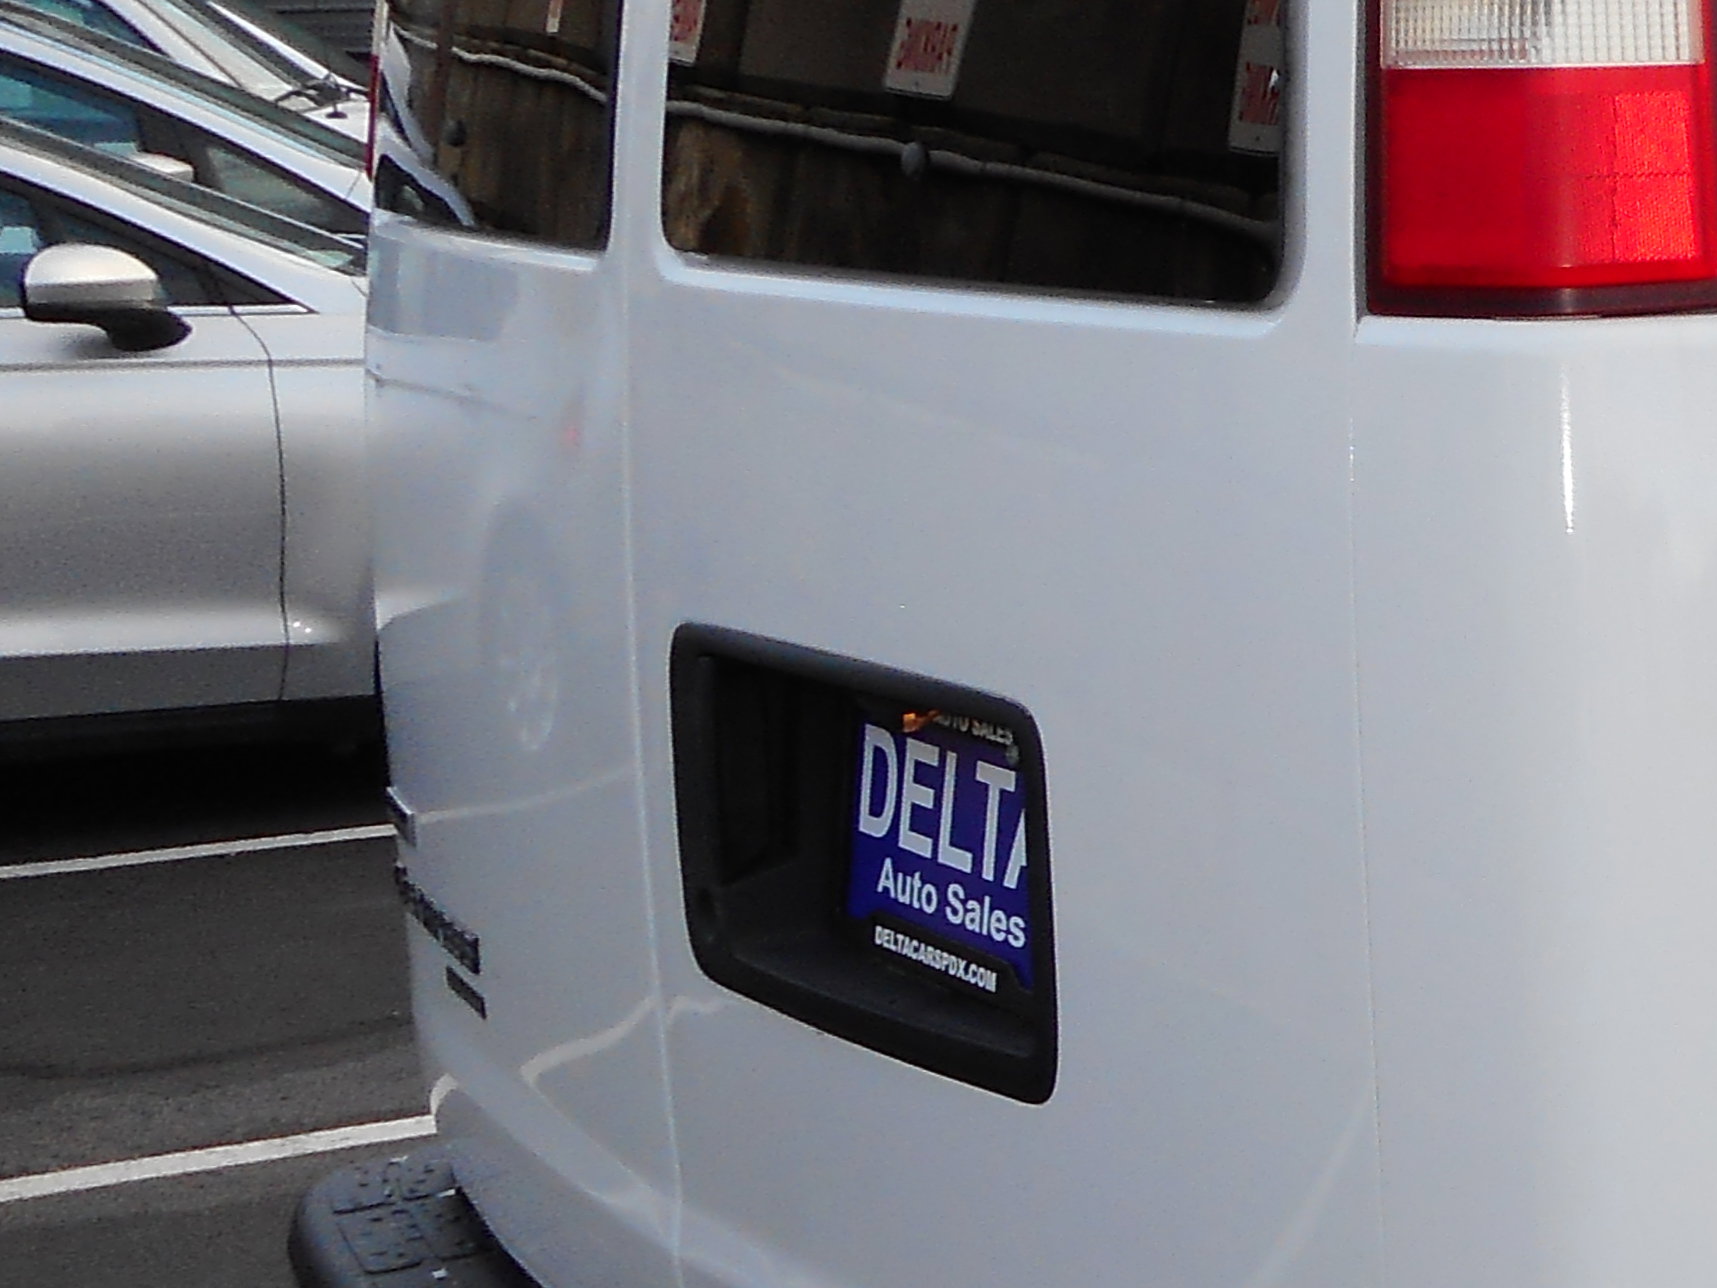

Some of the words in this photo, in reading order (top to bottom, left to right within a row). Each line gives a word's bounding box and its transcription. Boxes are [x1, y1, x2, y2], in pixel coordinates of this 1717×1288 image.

[876, 857, 938, 915] Auto
[945, 883, 1027, 949] Sales
[874, 925, 998, 994] DELTACARSPDX.COM
